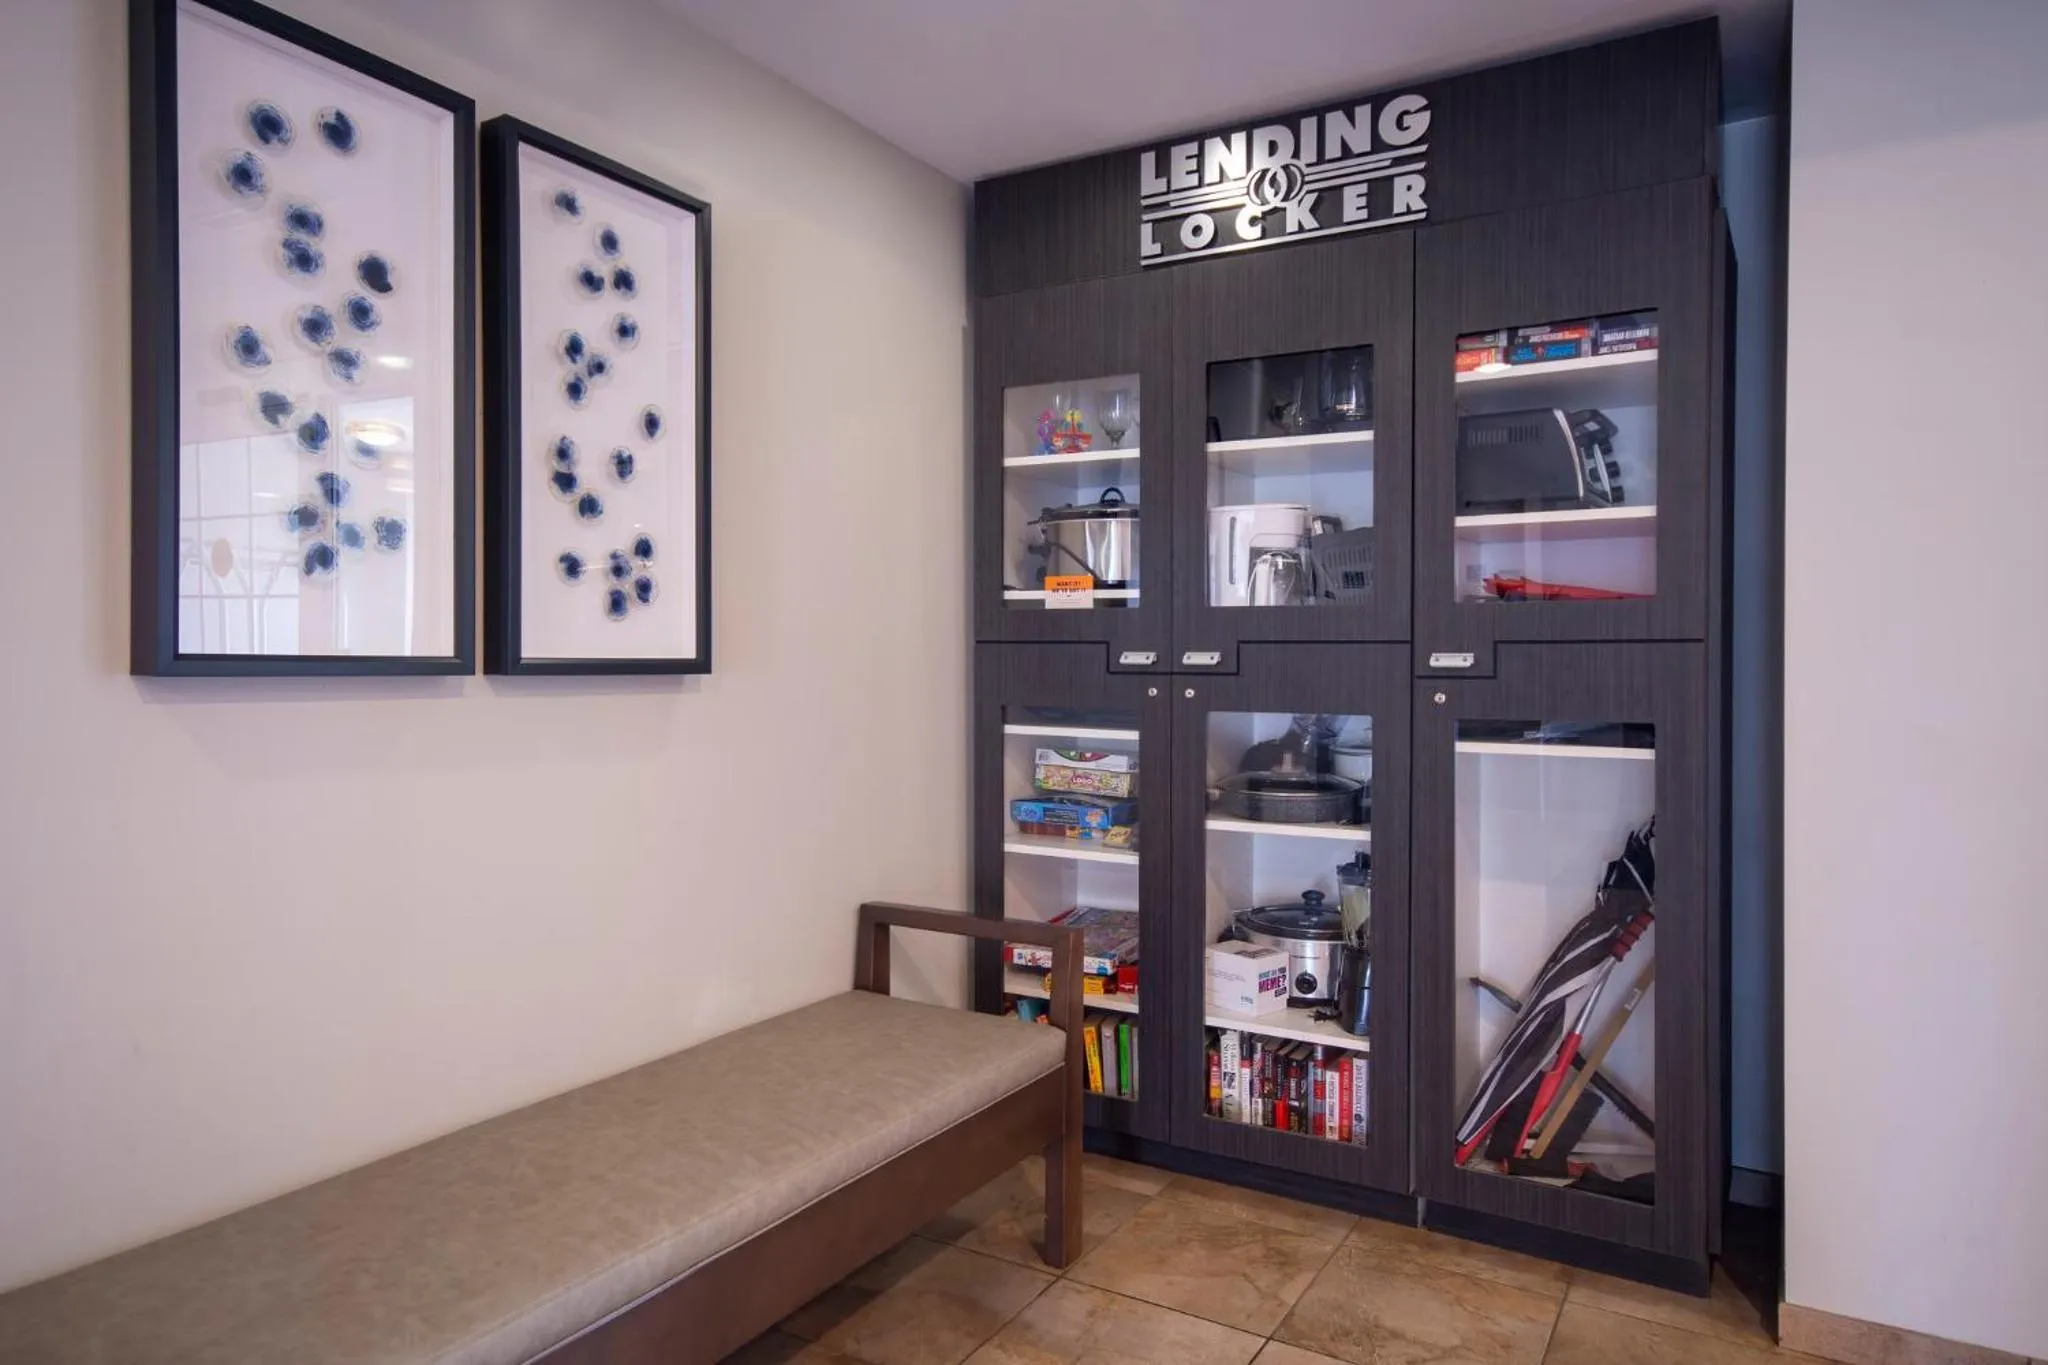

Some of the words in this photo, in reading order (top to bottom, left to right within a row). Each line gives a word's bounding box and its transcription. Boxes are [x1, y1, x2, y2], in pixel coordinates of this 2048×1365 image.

[1140, 94, 1431, 196] LENDING
[1140, 174, 1428, 258] LOCKER
[1258, 974, 1287, 993] MEME?
